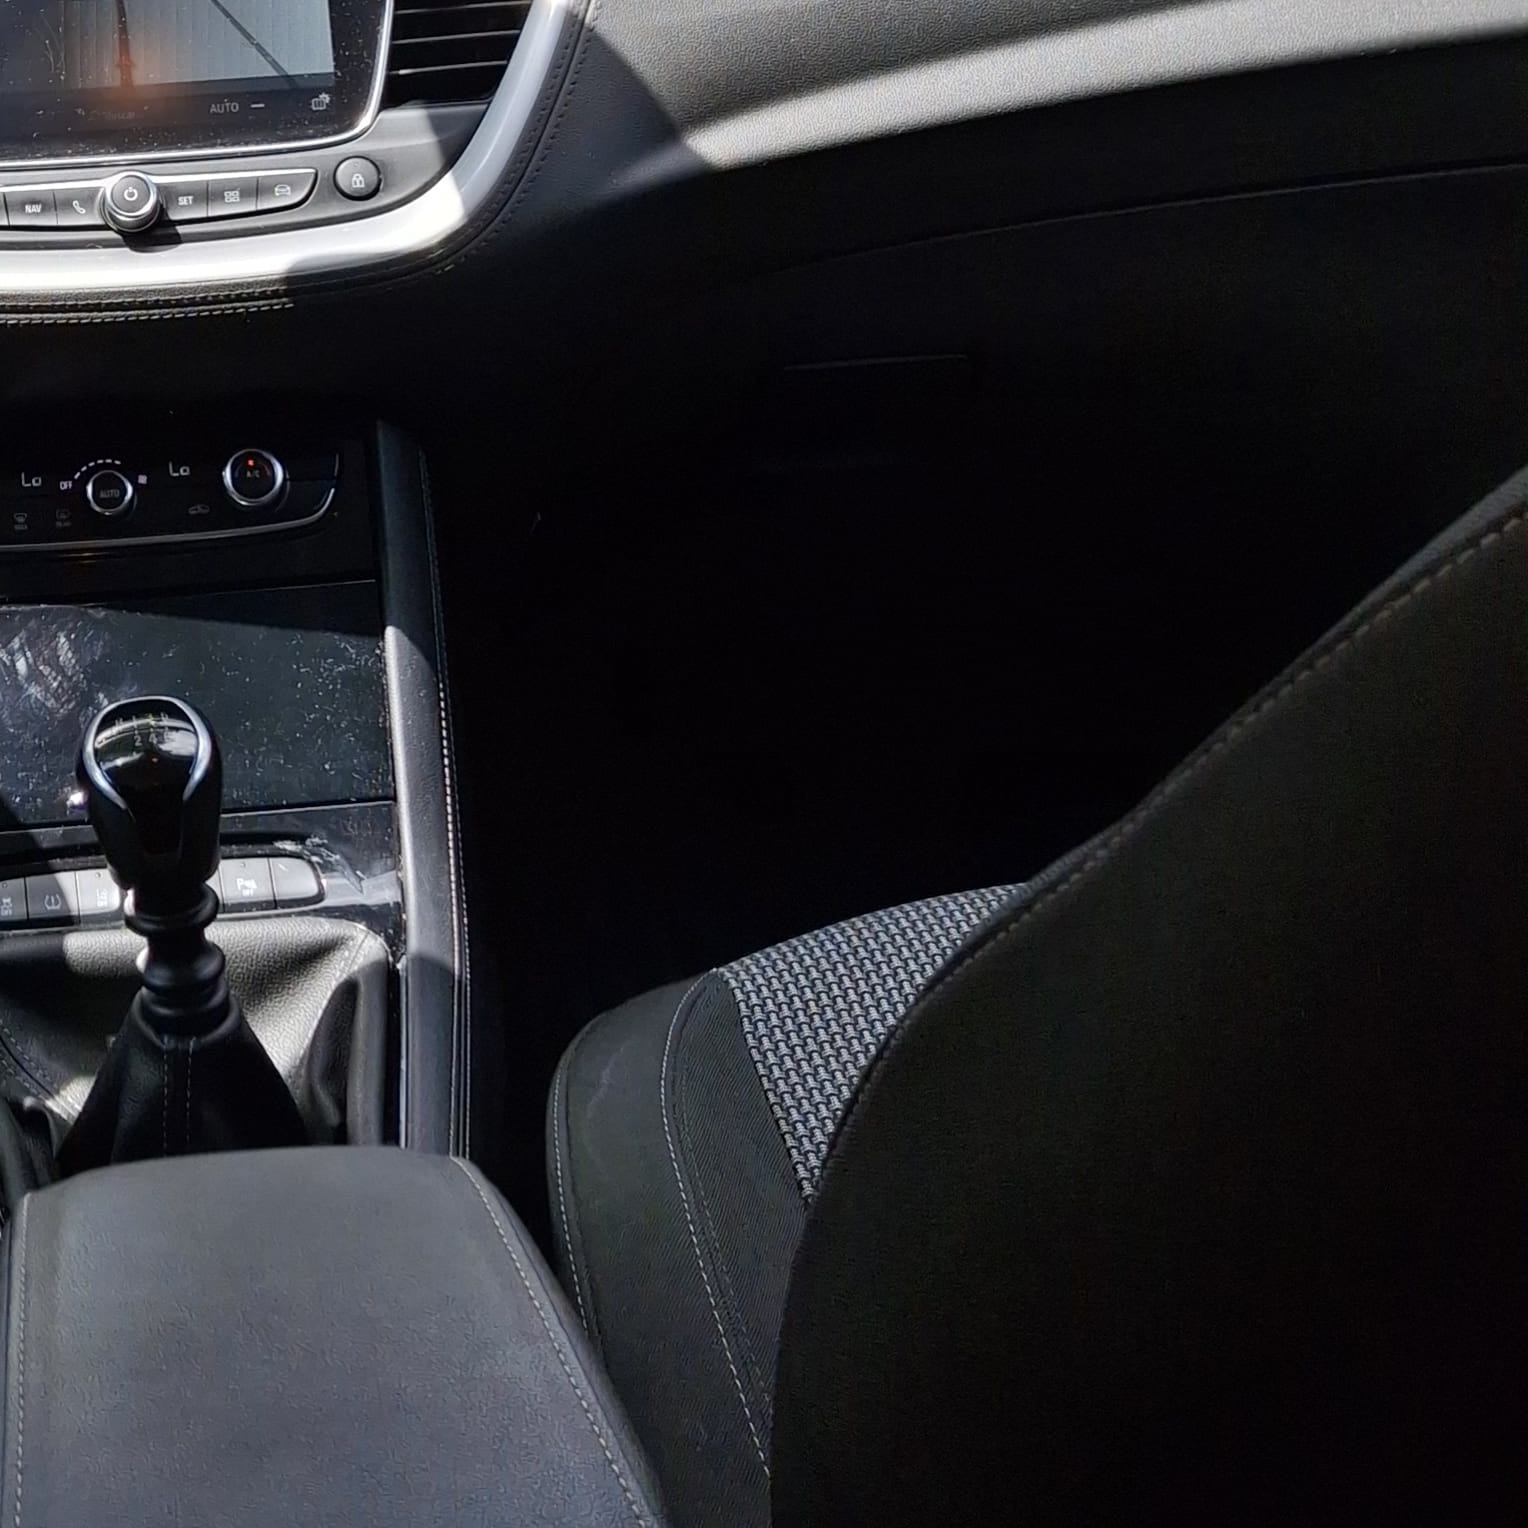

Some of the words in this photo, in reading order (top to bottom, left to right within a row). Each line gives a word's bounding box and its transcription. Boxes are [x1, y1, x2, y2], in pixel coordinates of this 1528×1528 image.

[210, 101, 240, 114] AUTO
[178, 195, 193, 206] SET
[25, 204, 42, 213] NAV
